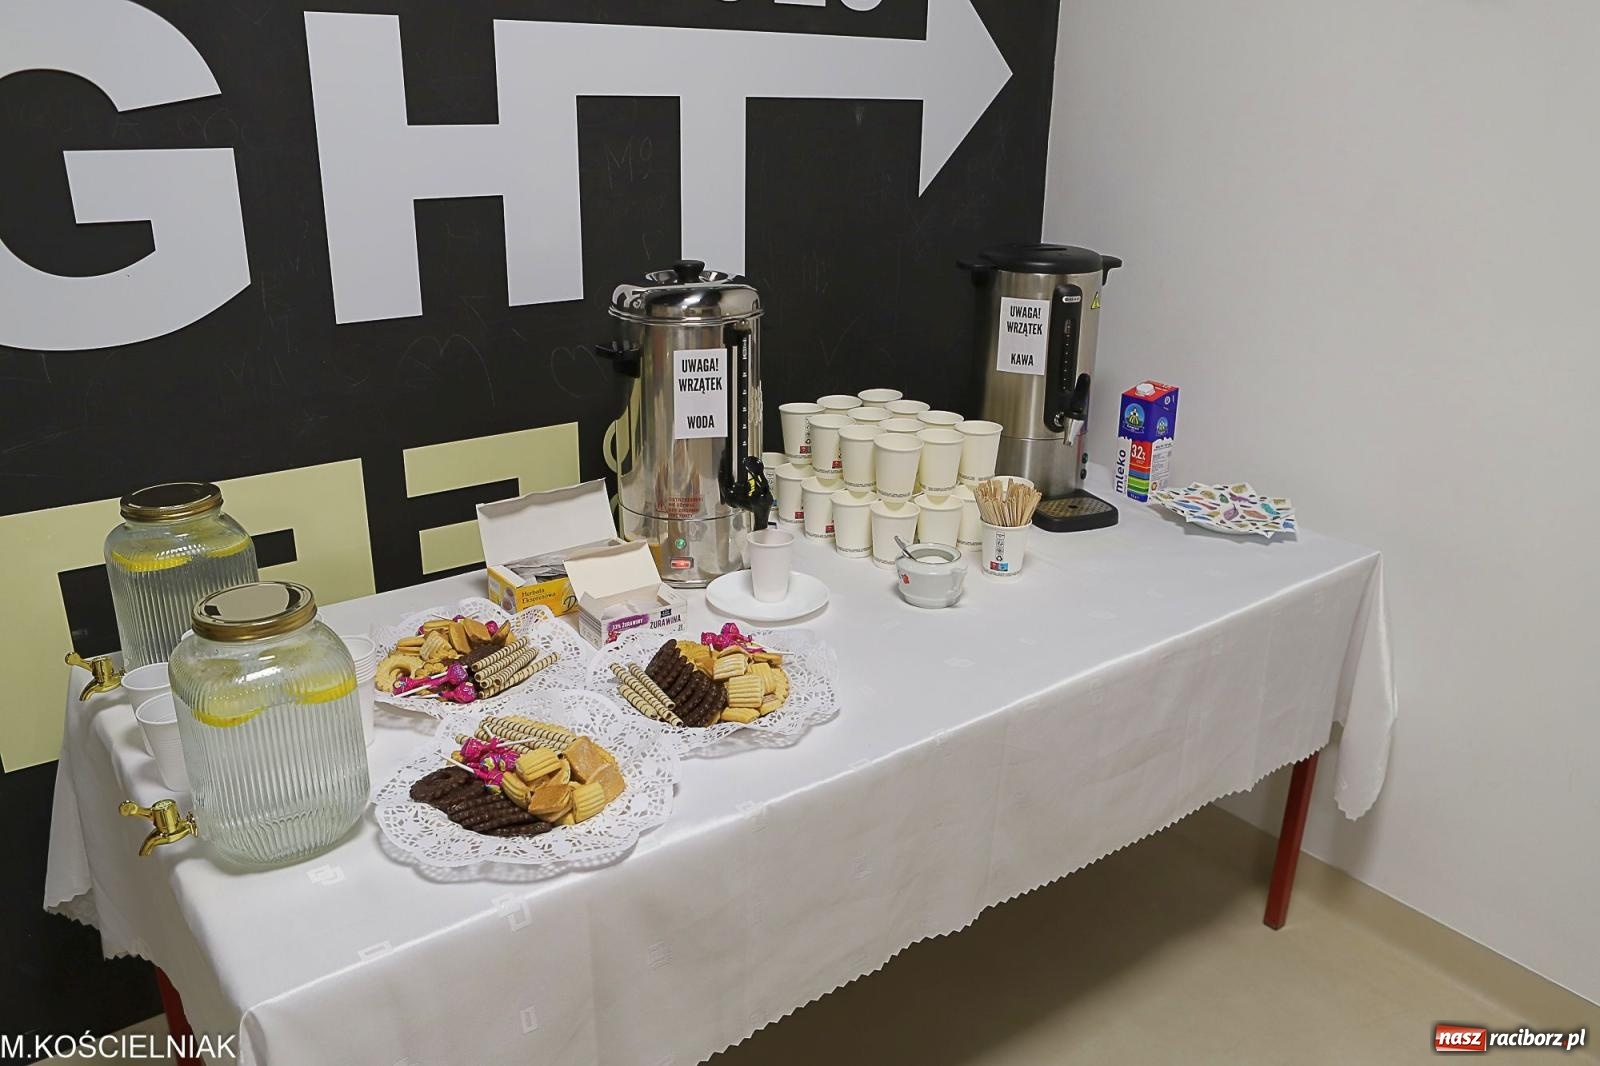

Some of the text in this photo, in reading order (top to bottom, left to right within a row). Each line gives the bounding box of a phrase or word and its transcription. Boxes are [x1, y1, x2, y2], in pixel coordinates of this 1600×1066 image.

[1010, 305, 1042, 319] UWAGA!
[1007, 320, 1043, 336] WRZĄTEK
[681, 358, 720, 373] UWAGA!
[1010, 352, 1034, 367] KAWA
[678, 377, 723, 394] WRZĄTEK
[686, 414, 715, 430] WODA
[1115, 449, 1126, 493] mleko
[521, 588, 545, 598] Herbata
[522, 592, 557, 604] Ekspresowa
